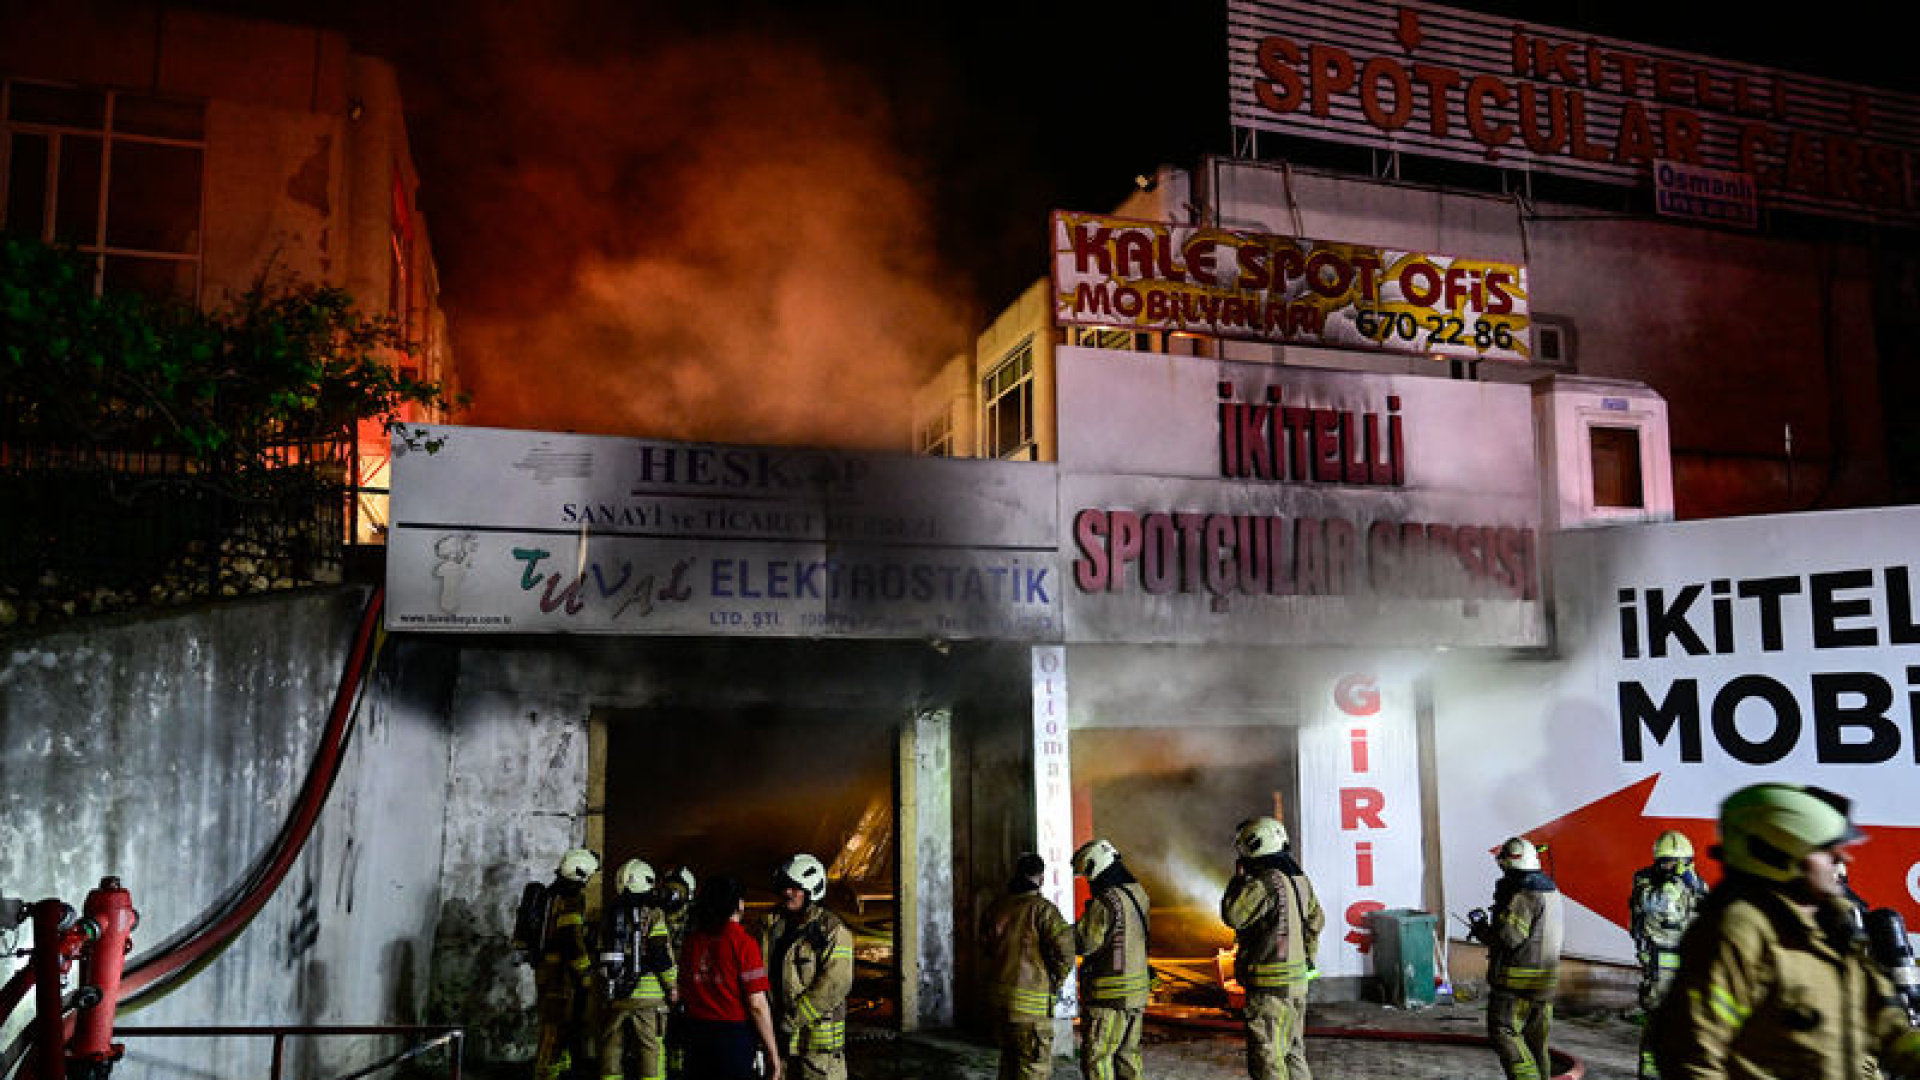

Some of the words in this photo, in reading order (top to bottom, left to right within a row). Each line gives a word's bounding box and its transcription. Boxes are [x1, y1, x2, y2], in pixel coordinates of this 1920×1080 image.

[1254, 36, 1701, 164] SPOTÇULAR
[1074, 224, 1219, 285] KALE
[1237, 243, 1382, 300] SPOT
[1355, 309, 1418, 342] 670
[1426, 315, 1465, 346] 22
[1473, 320, 1514, 350] 86
[639, 446, 868, 492] HESKP
[1072, 508, 1355, 613] SPOTÇULAR
